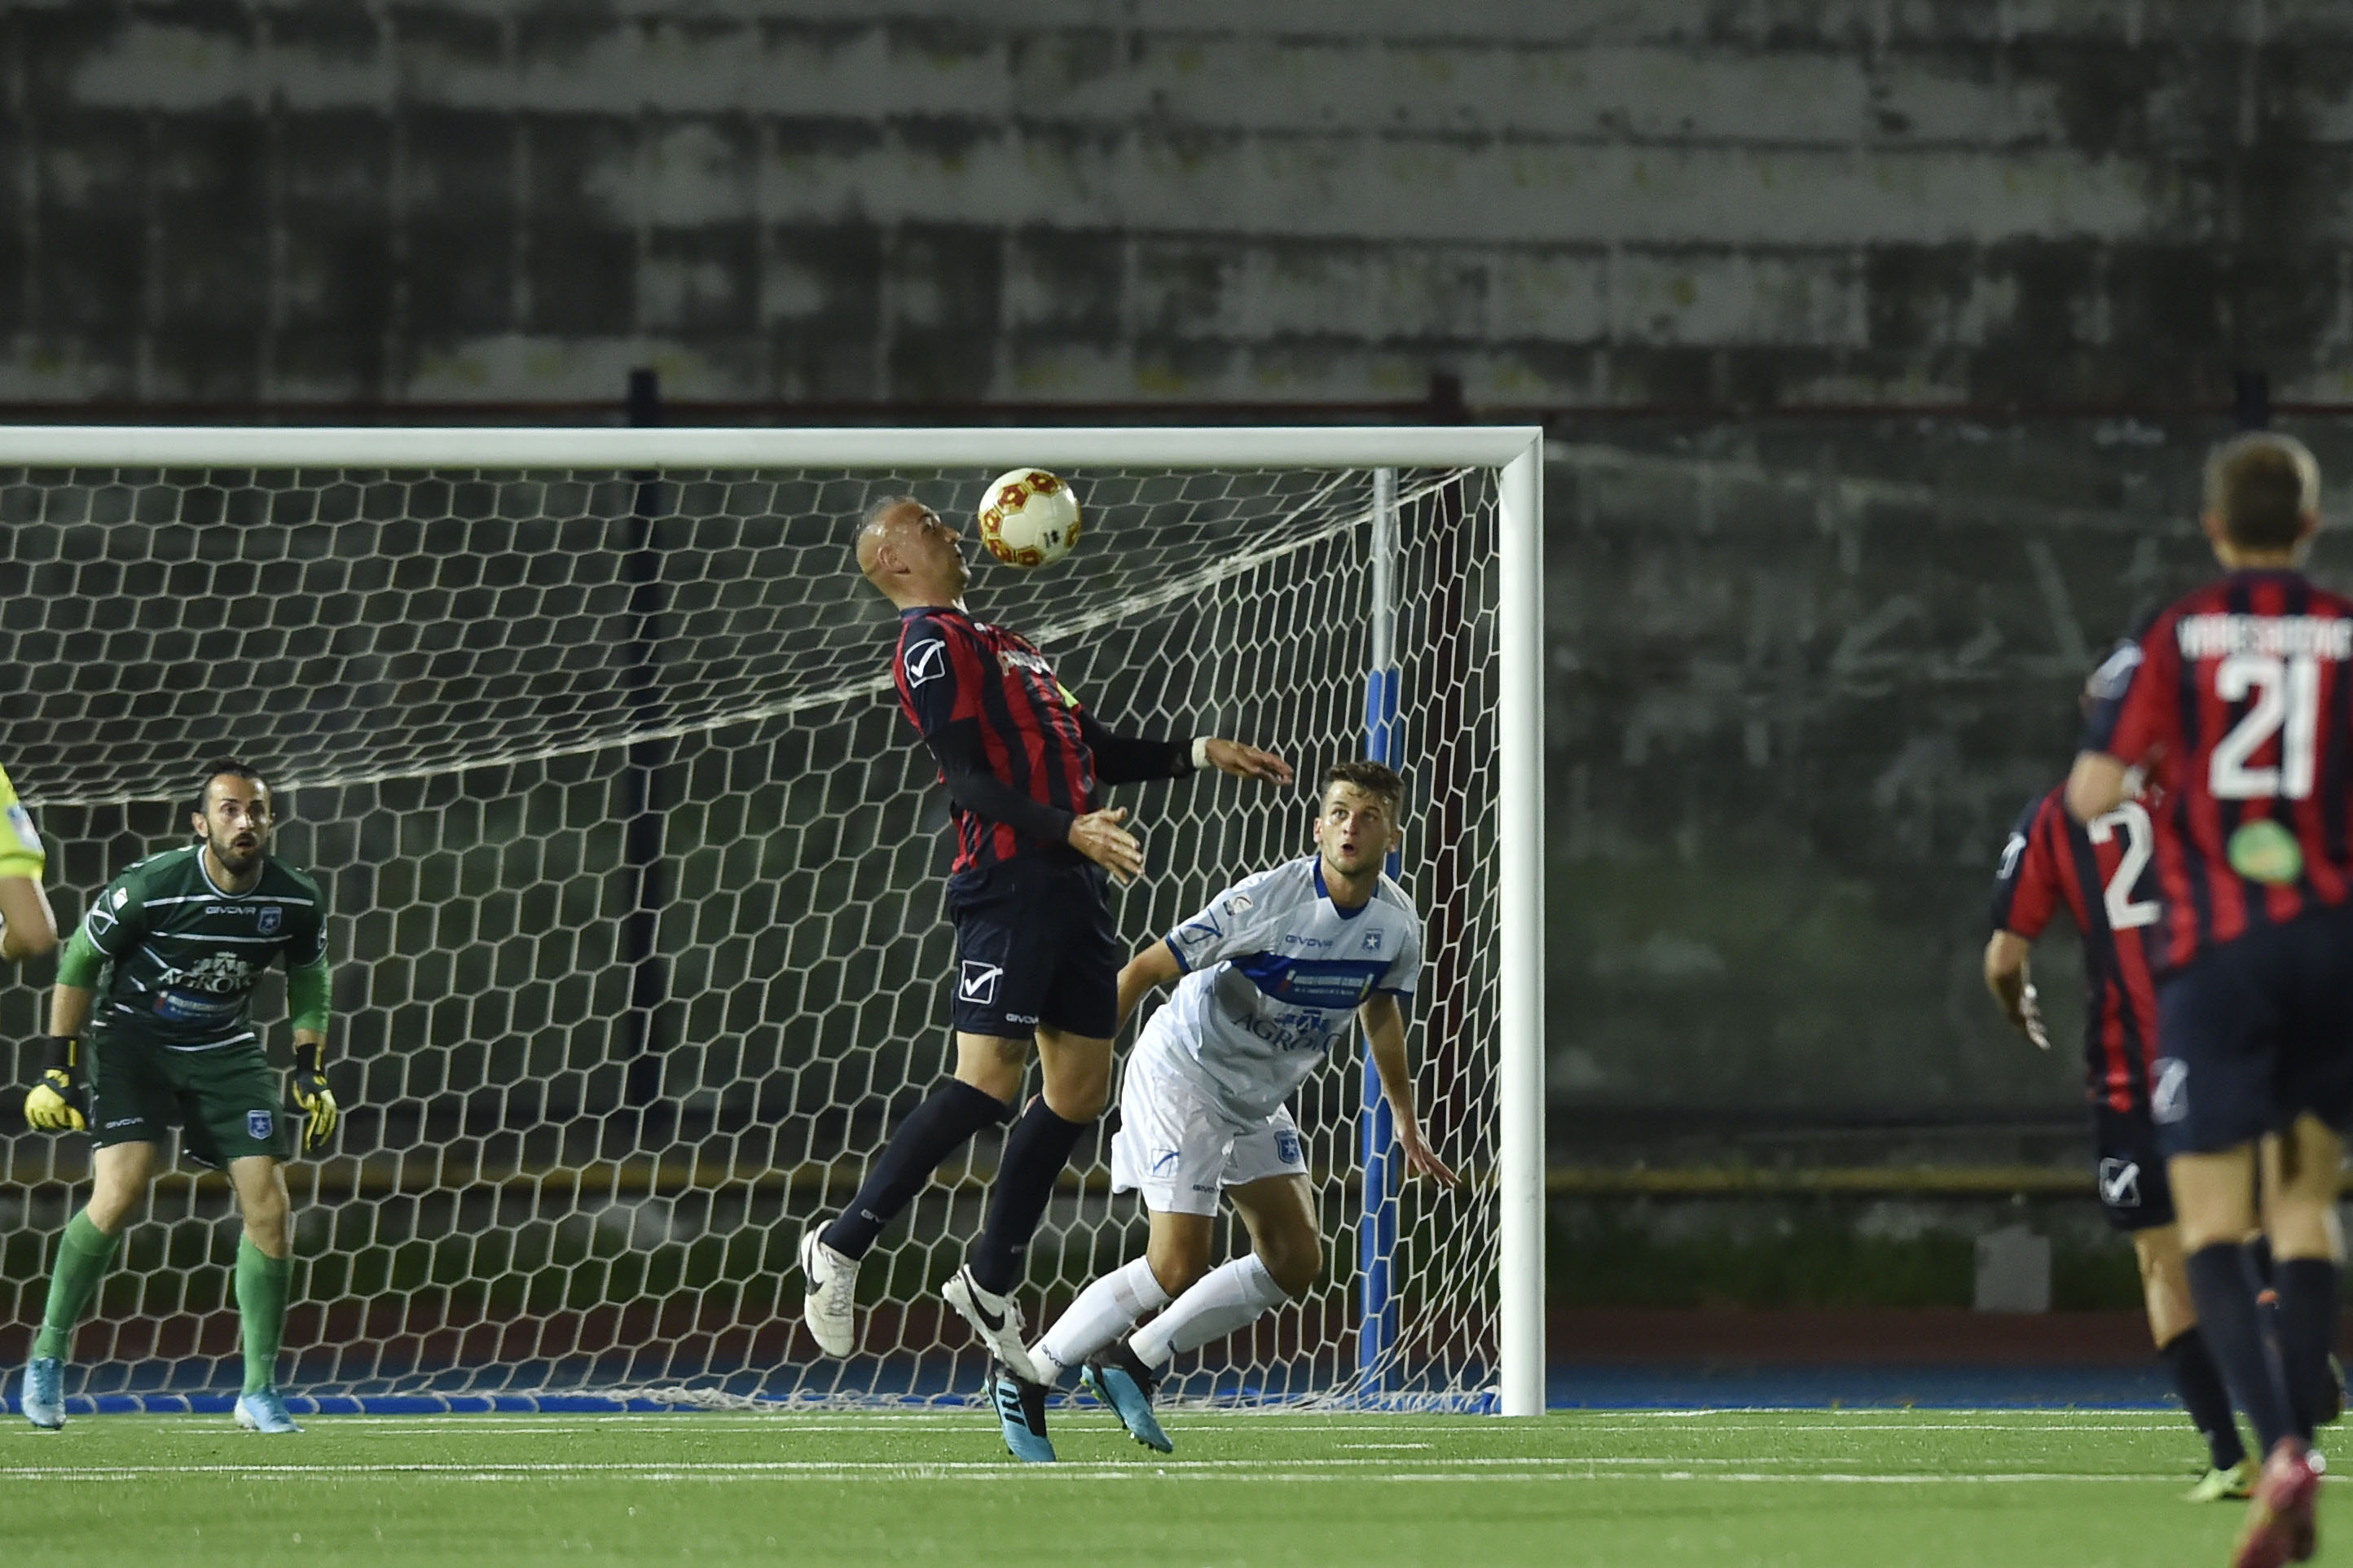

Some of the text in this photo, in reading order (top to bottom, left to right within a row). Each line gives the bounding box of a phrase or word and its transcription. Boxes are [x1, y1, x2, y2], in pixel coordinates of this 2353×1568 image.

[2209, 654, 2321, 799] 21
[205, 906, 257, 915] GIVOVA
[1005, 1012, 1040, 1024] GIVOV
